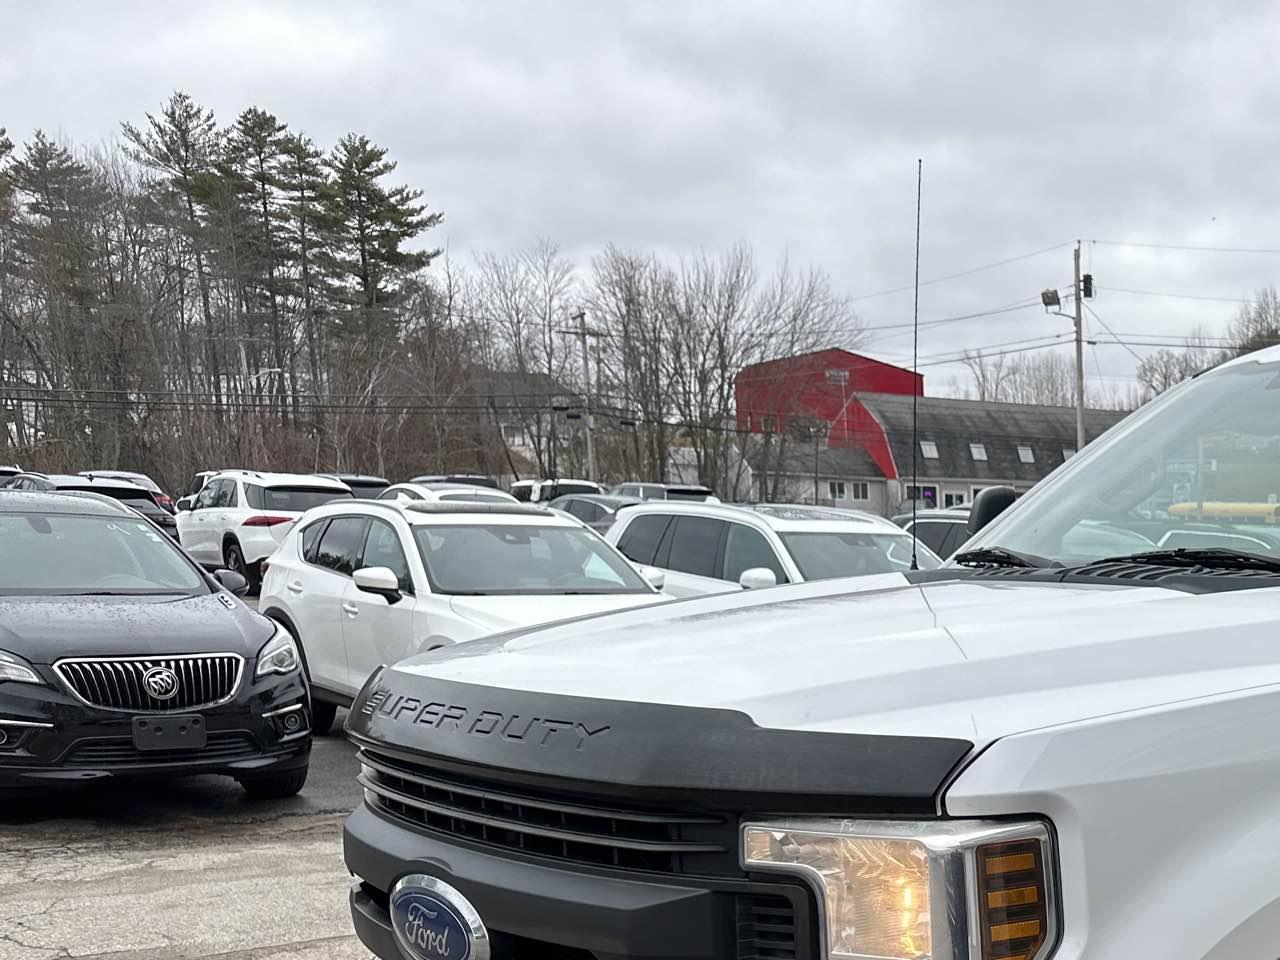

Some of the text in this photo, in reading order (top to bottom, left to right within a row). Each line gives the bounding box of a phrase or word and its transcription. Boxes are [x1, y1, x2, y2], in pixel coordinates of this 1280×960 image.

[361, 689, 611, 749] SUPER DUTY
[405, 902, 450, 957] Ford
